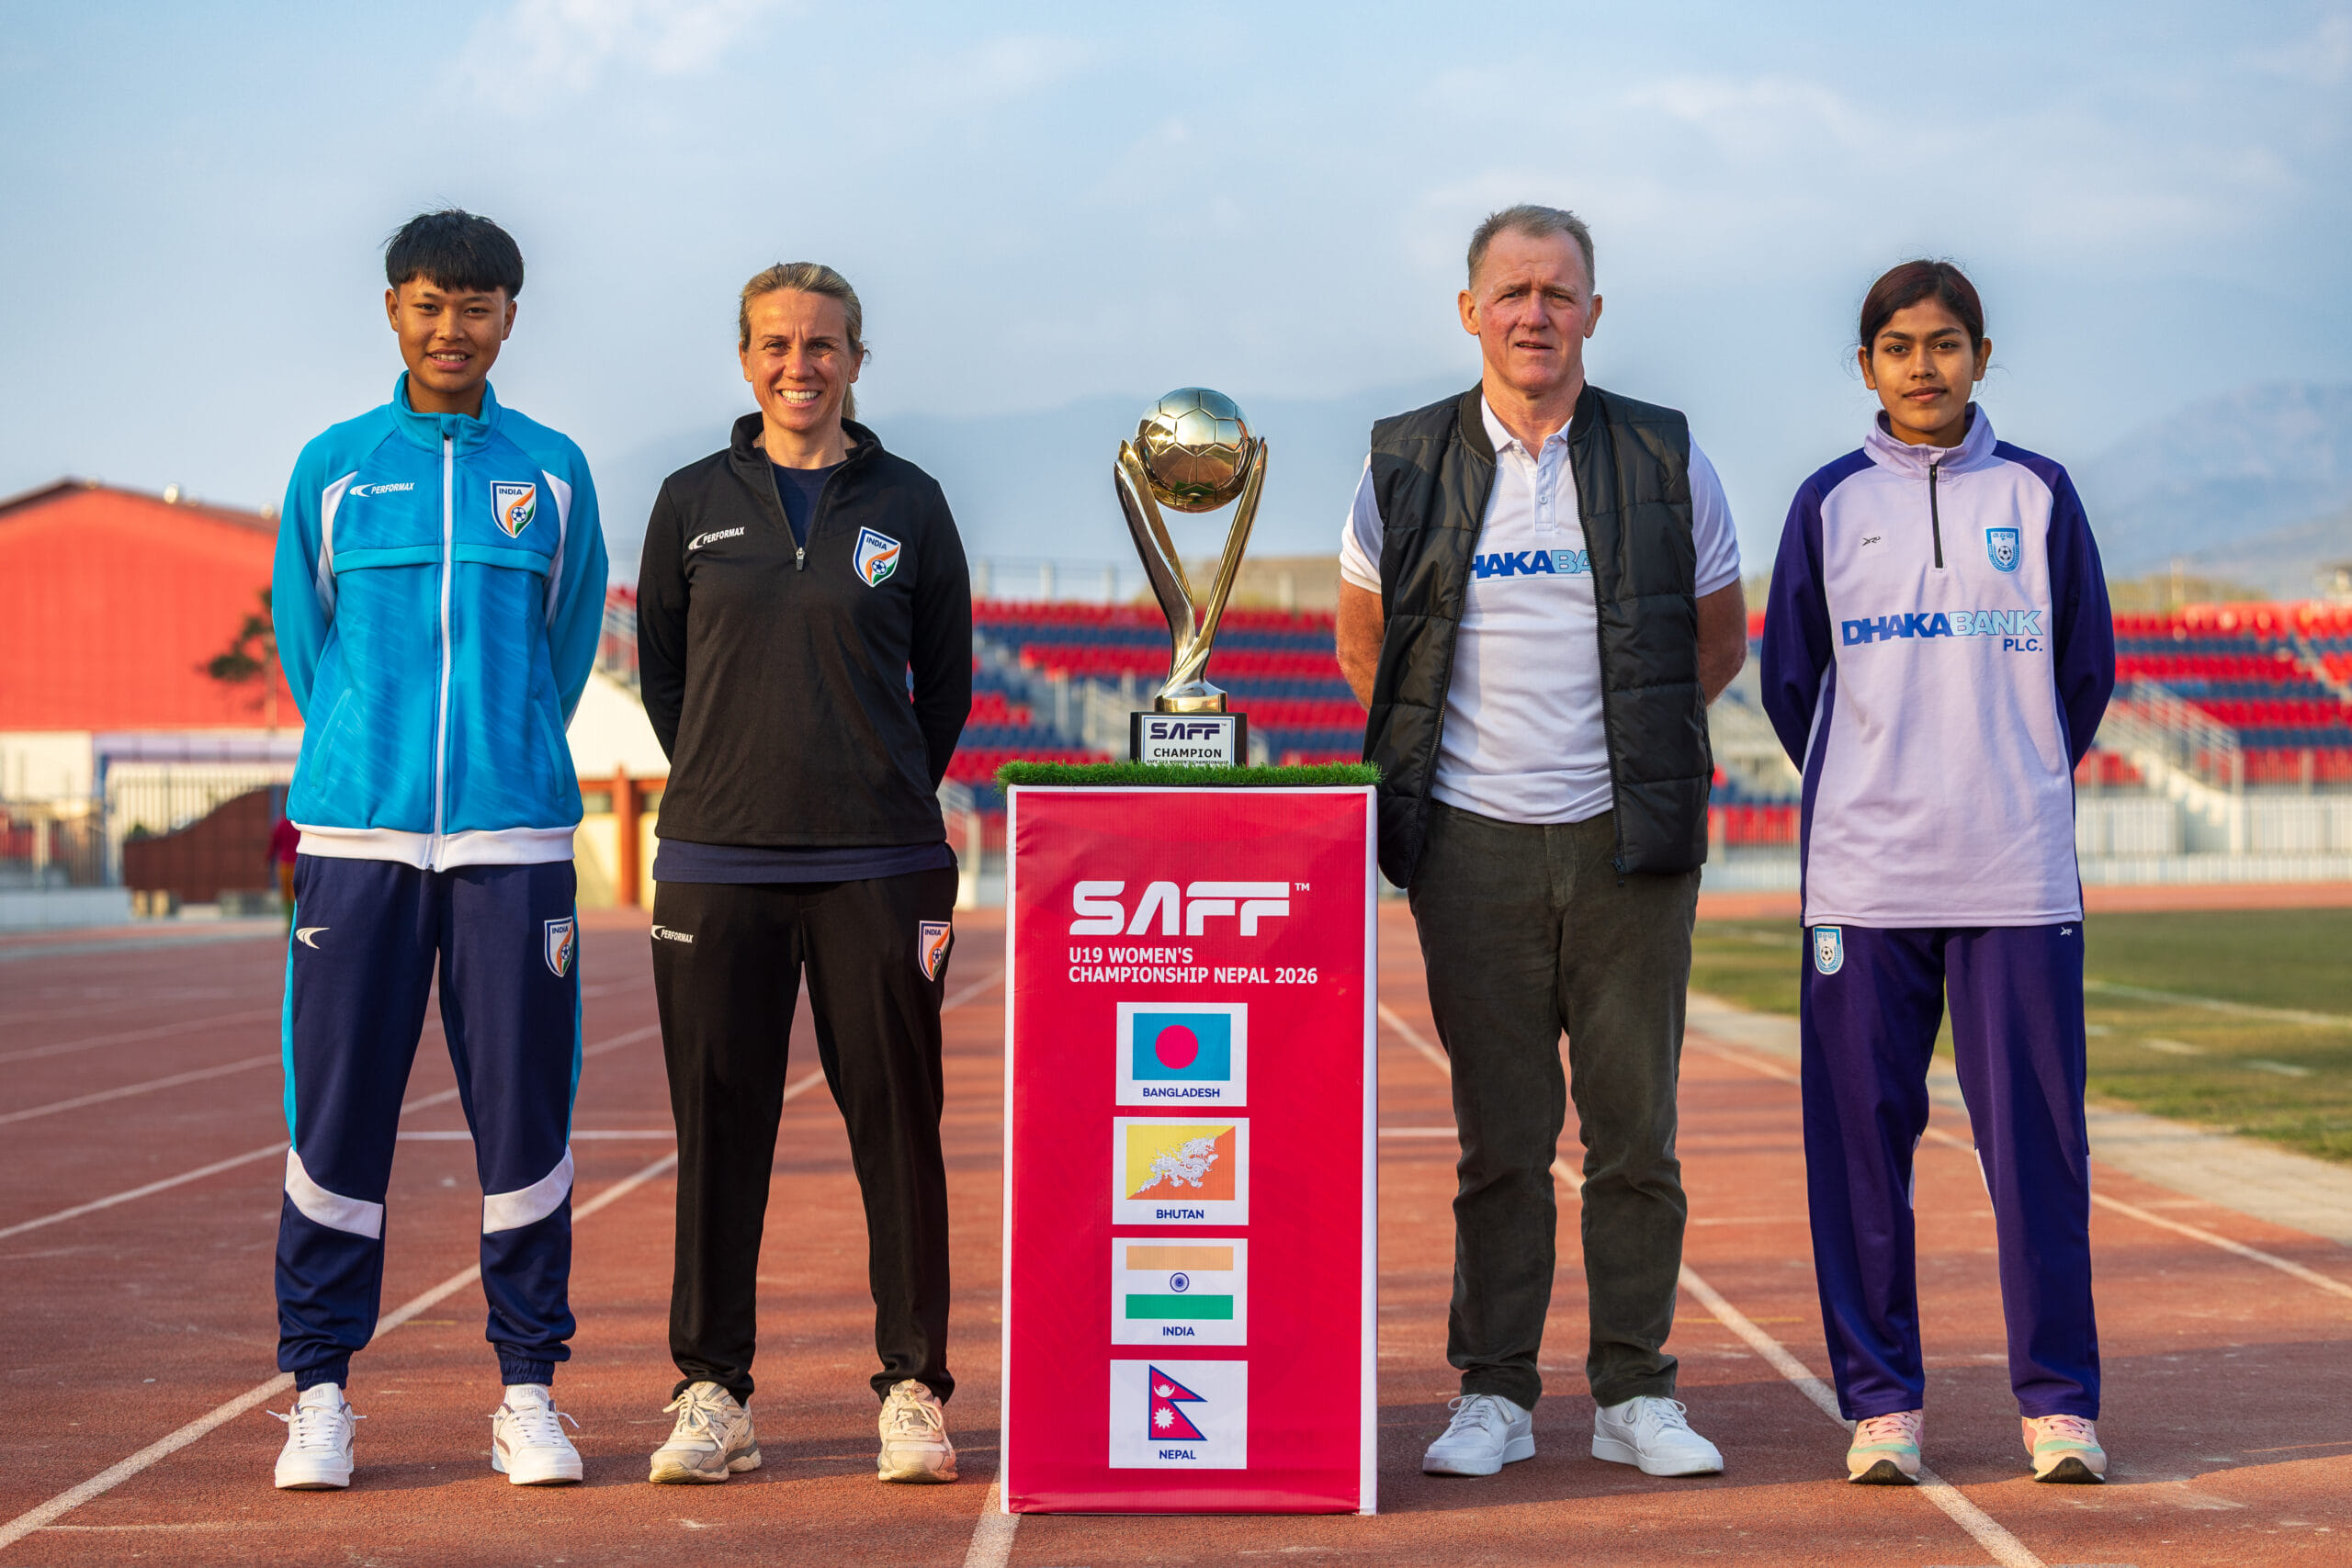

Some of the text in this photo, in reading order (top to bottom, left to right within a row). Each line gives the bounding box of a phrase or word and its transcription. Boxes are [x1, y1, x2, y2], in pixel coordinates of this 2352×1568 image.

[370, 482, 415, 494] PERFORMAX
[498, 488, 523, 496] INDIA
[703, 526, 745, 545] PERFORMAX
[865, 536, 888, 551] INDIA
[2003, 638, 2043, 652] PLC.
[1149, 722, 1220, 740] SAFF
[1153, 748, 1222, 758] CHAMPION
[1069, 880, 1290, 936] SAFF
[551, 925, 569, 934] INDIA
[924, 928, 942, 936] INDIA
[661, 929, 694, 943] PERFORMAX
[1069, 947, 1193, 964] U19 WOMEN'S
[1069, 966, 1318, 984] CHAMPIONSHIP NEPAL 2026
[1142, 1088, 1220, 1098] BANGLADESH
[1156, 1209, 1204, 1219] BHUTAN
[1162, 1326, 1195, 1337] INDIA
[1159, 1450, 1197, 1460] NEPAL
